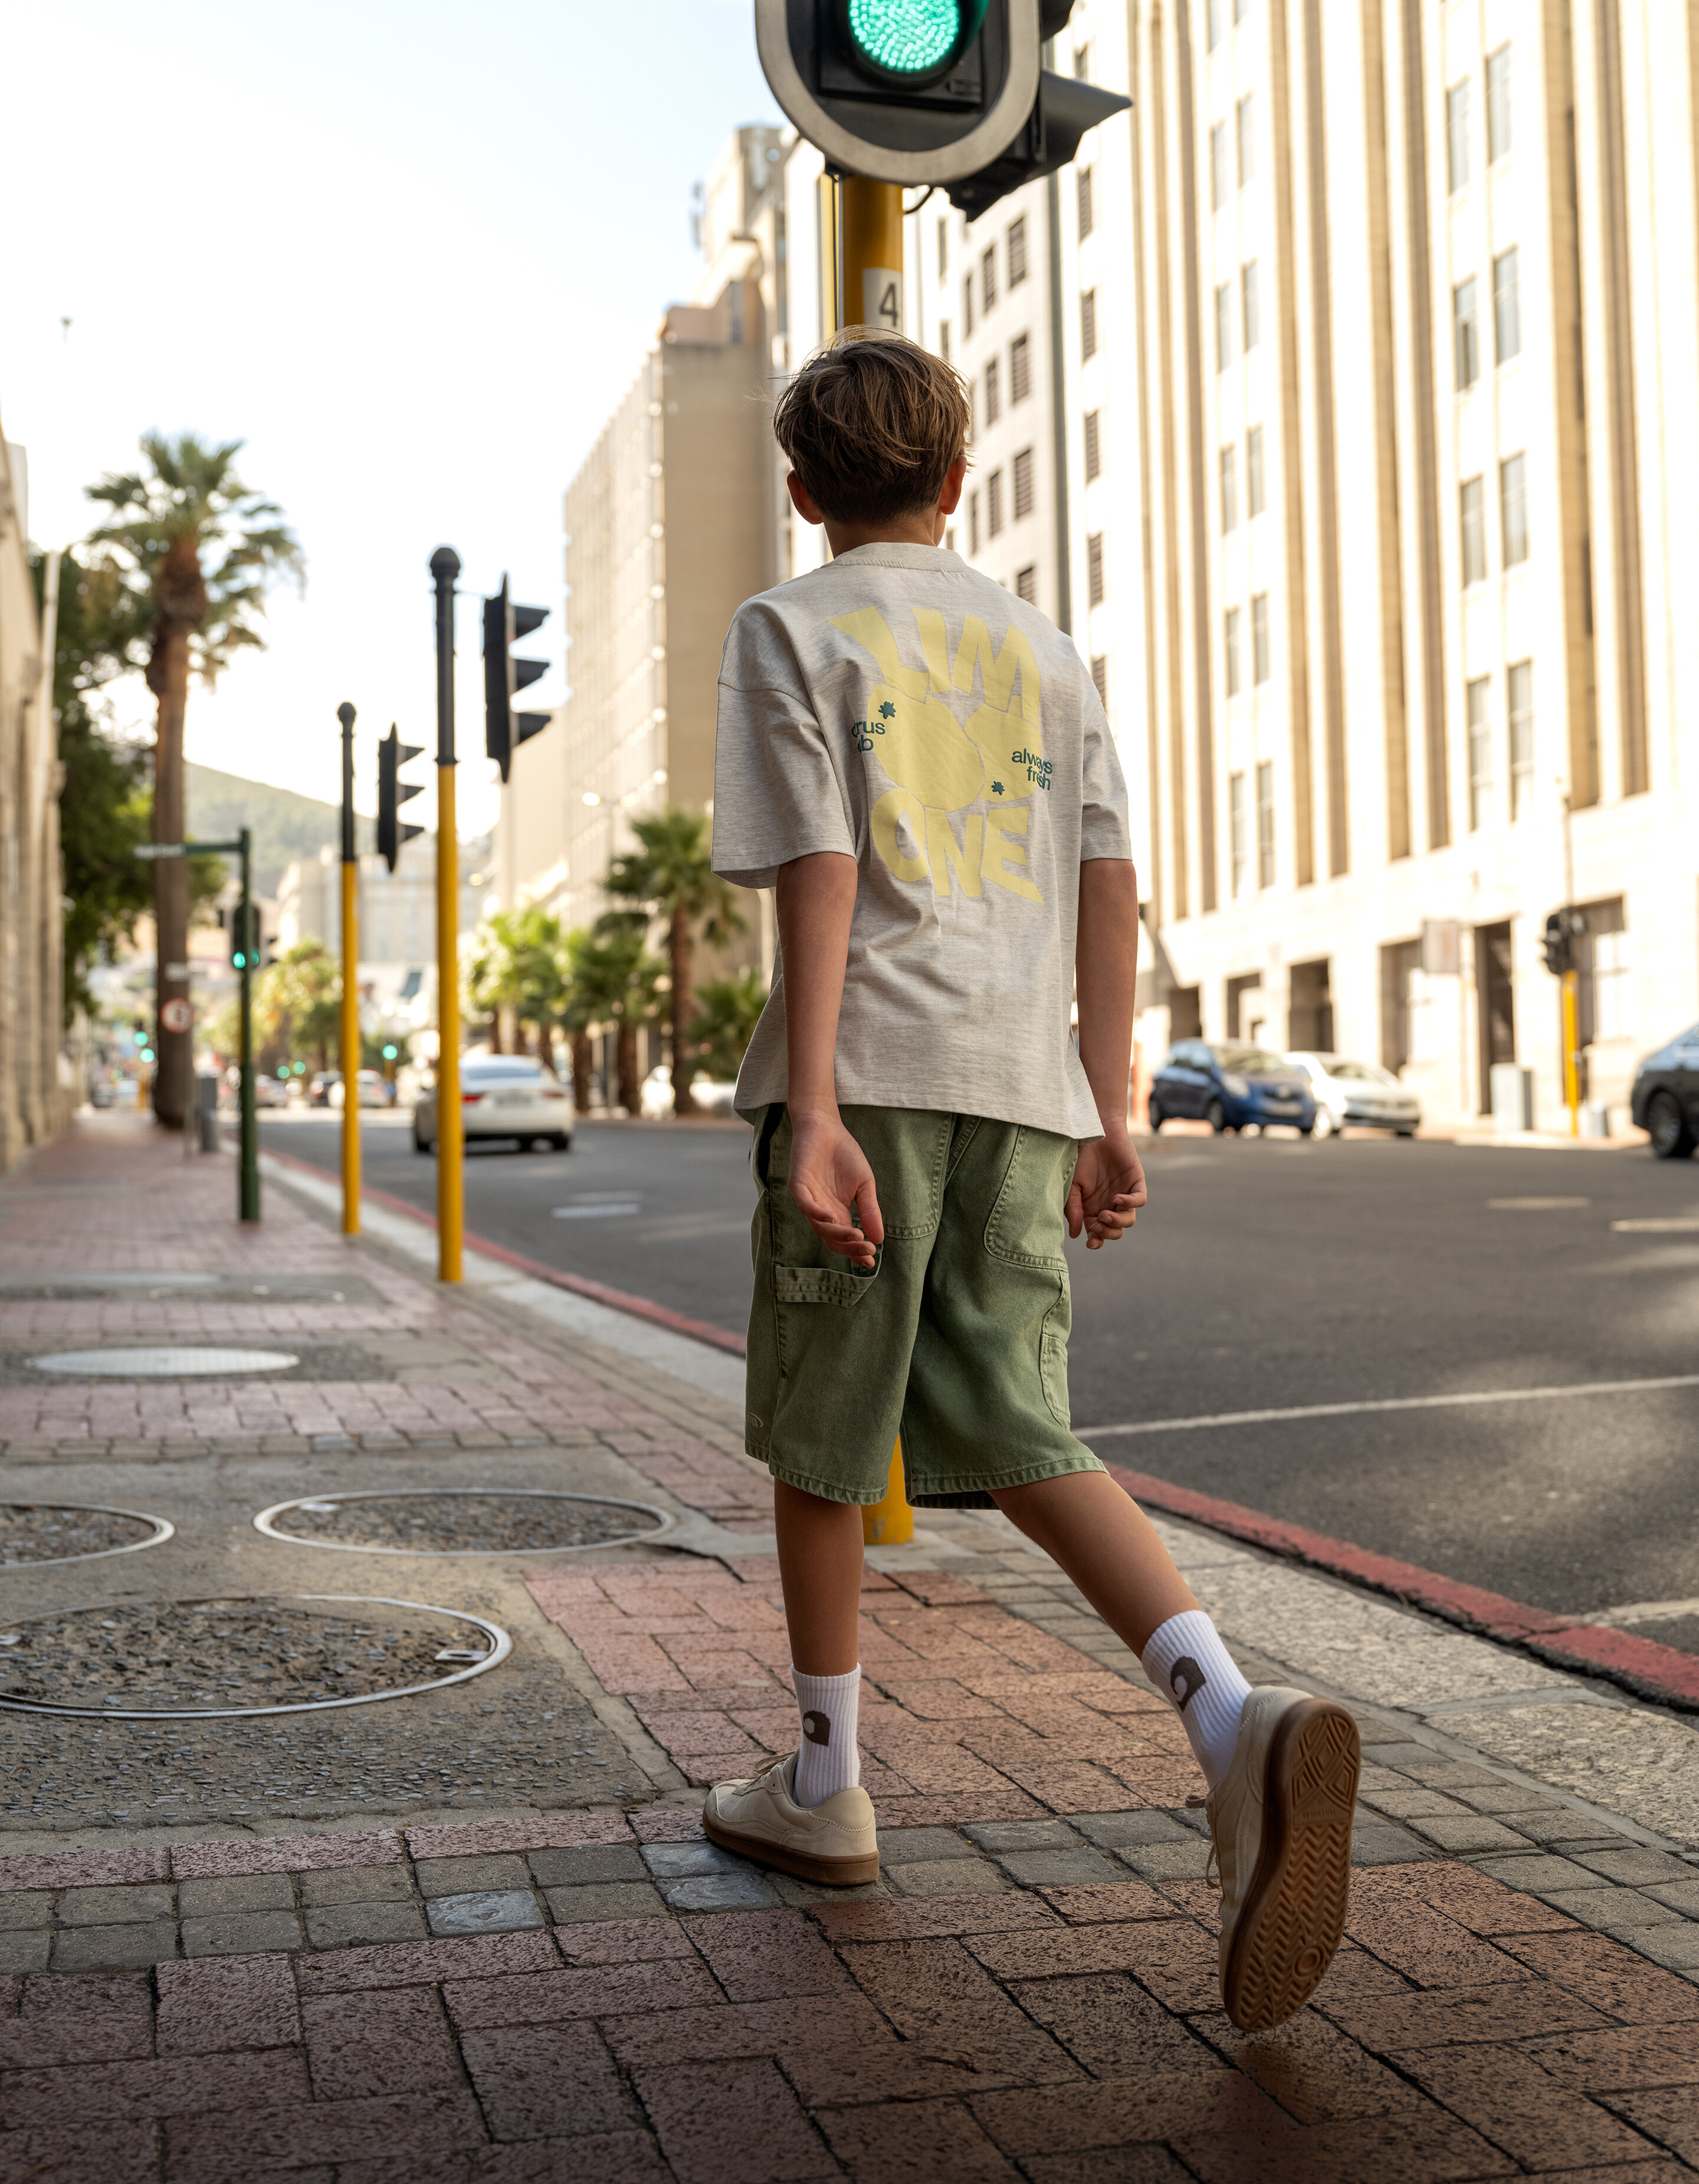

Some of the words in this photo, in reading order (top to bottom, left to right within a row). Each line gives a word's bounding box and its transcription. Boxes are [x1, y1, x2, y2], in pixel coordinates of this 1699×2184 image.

[879, 283, 898, 327] 4
[1011, 748, 1053, 774] always
[1026, 766, 1051, 791] fresh
[871, 787, 1045, 905] ONE
